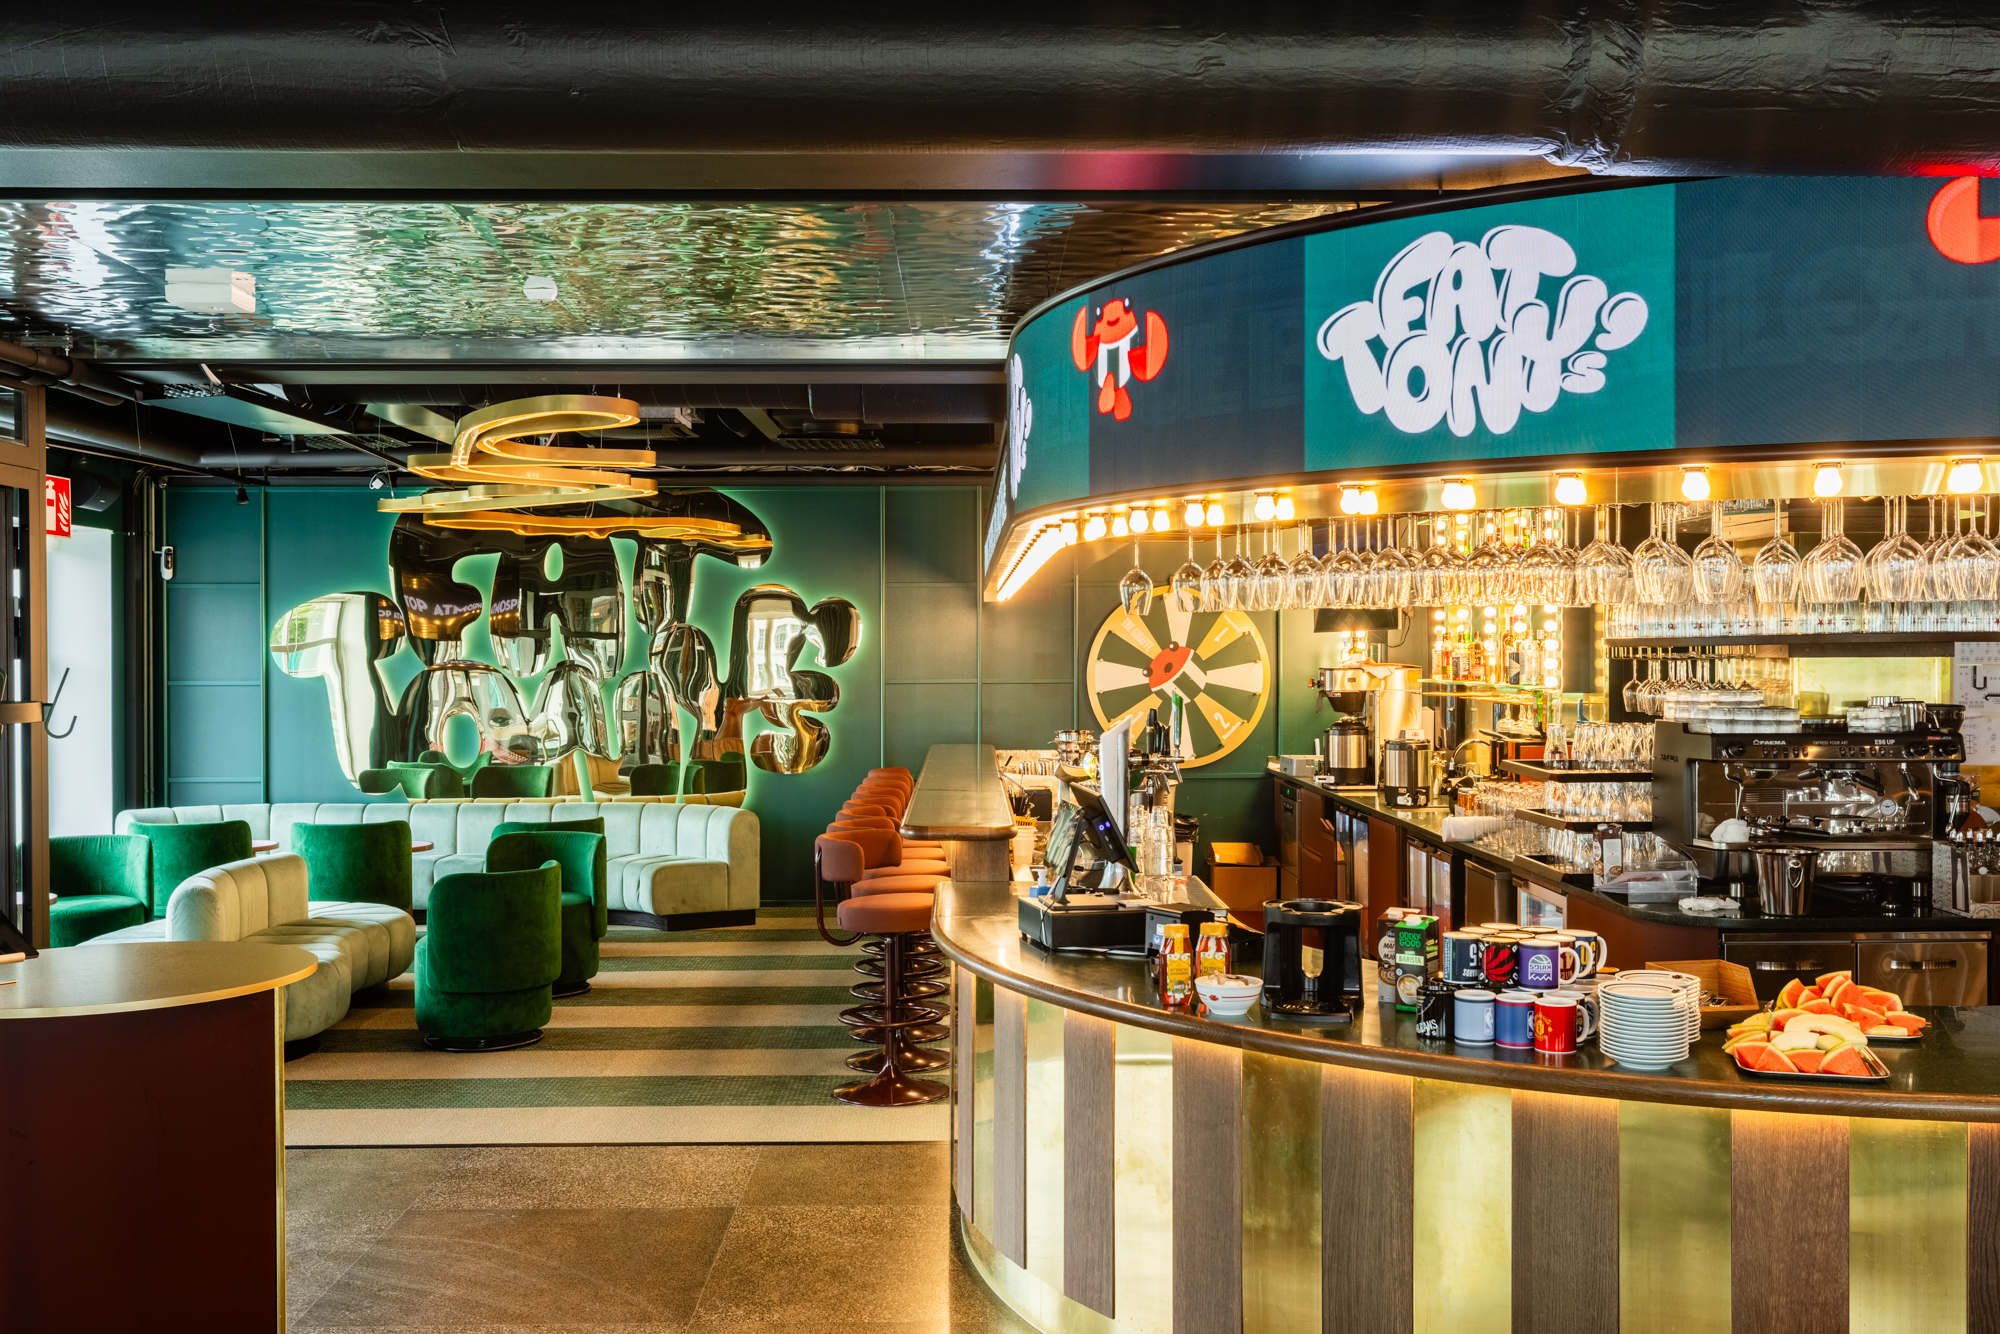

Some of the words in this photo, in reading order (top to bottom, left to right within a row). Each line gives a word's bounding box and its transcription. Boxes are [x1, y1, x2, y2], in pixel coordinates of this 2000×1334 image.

[1373, 225, 1577, 342] FAT
[388, 487, 773, 681] FAT
[404, 594, 428, 613] TOP
[1121, 617, 1136, 633] THE
[1130, 627, 1155, 653] GIRAFFE
[1213, 712, 1231, 729] 2
[1222, 721, 1242, 740] Heineken
[1399, 939, 1422, 948] GOOD
[1398, 955, 1422, 964] BARISTA
